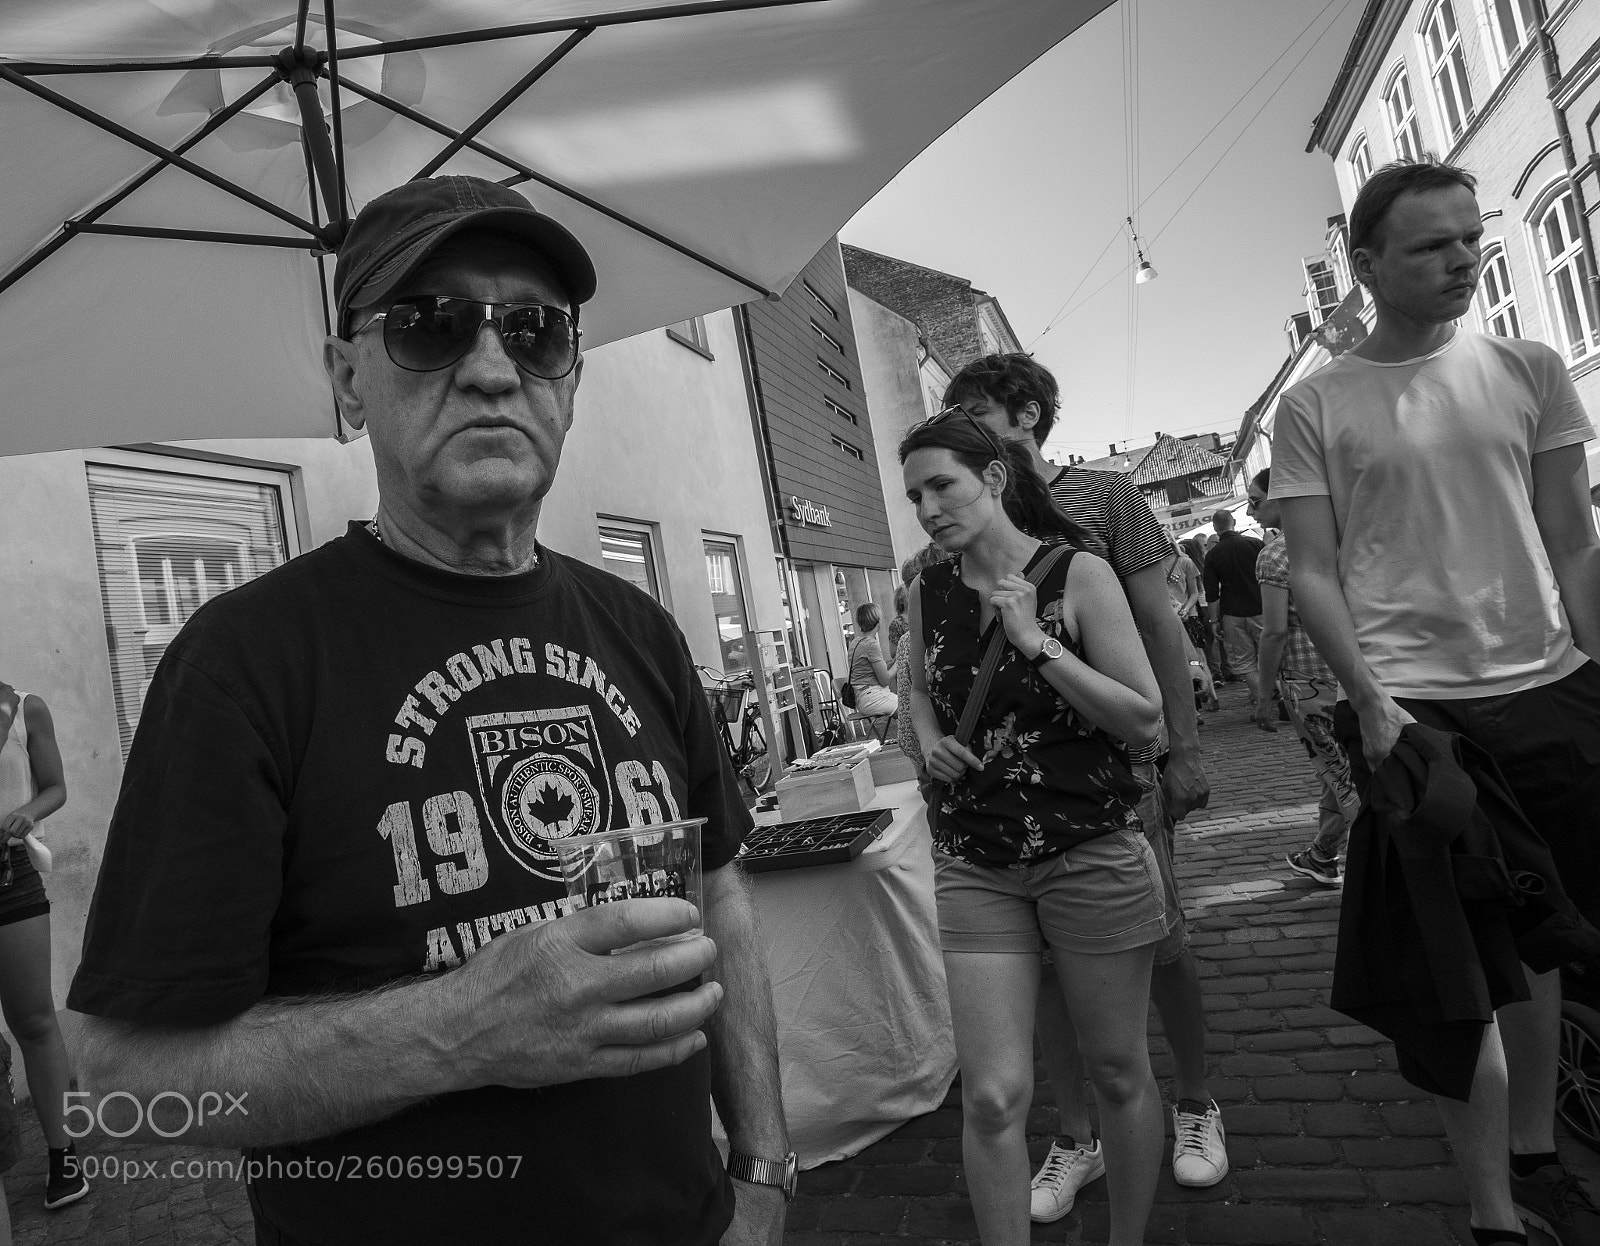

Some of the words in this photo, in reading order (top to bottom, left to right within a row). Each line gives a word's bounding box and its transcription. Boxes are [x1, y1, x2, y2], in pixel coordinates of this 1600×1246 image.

[792, 496, 832, 527] Sydbank
[386, 637, 537, 769] STRONG
[544, 642, 642, 738] SINCE
[479, 720, 590, 754] BISON
[509, 761, 557, 806] AUTHENTIC
[557, 764, 593, 835] SPORTSWEAR
[376, 790, 489, 908] 19
[509, 809, 534, 845] BISON
